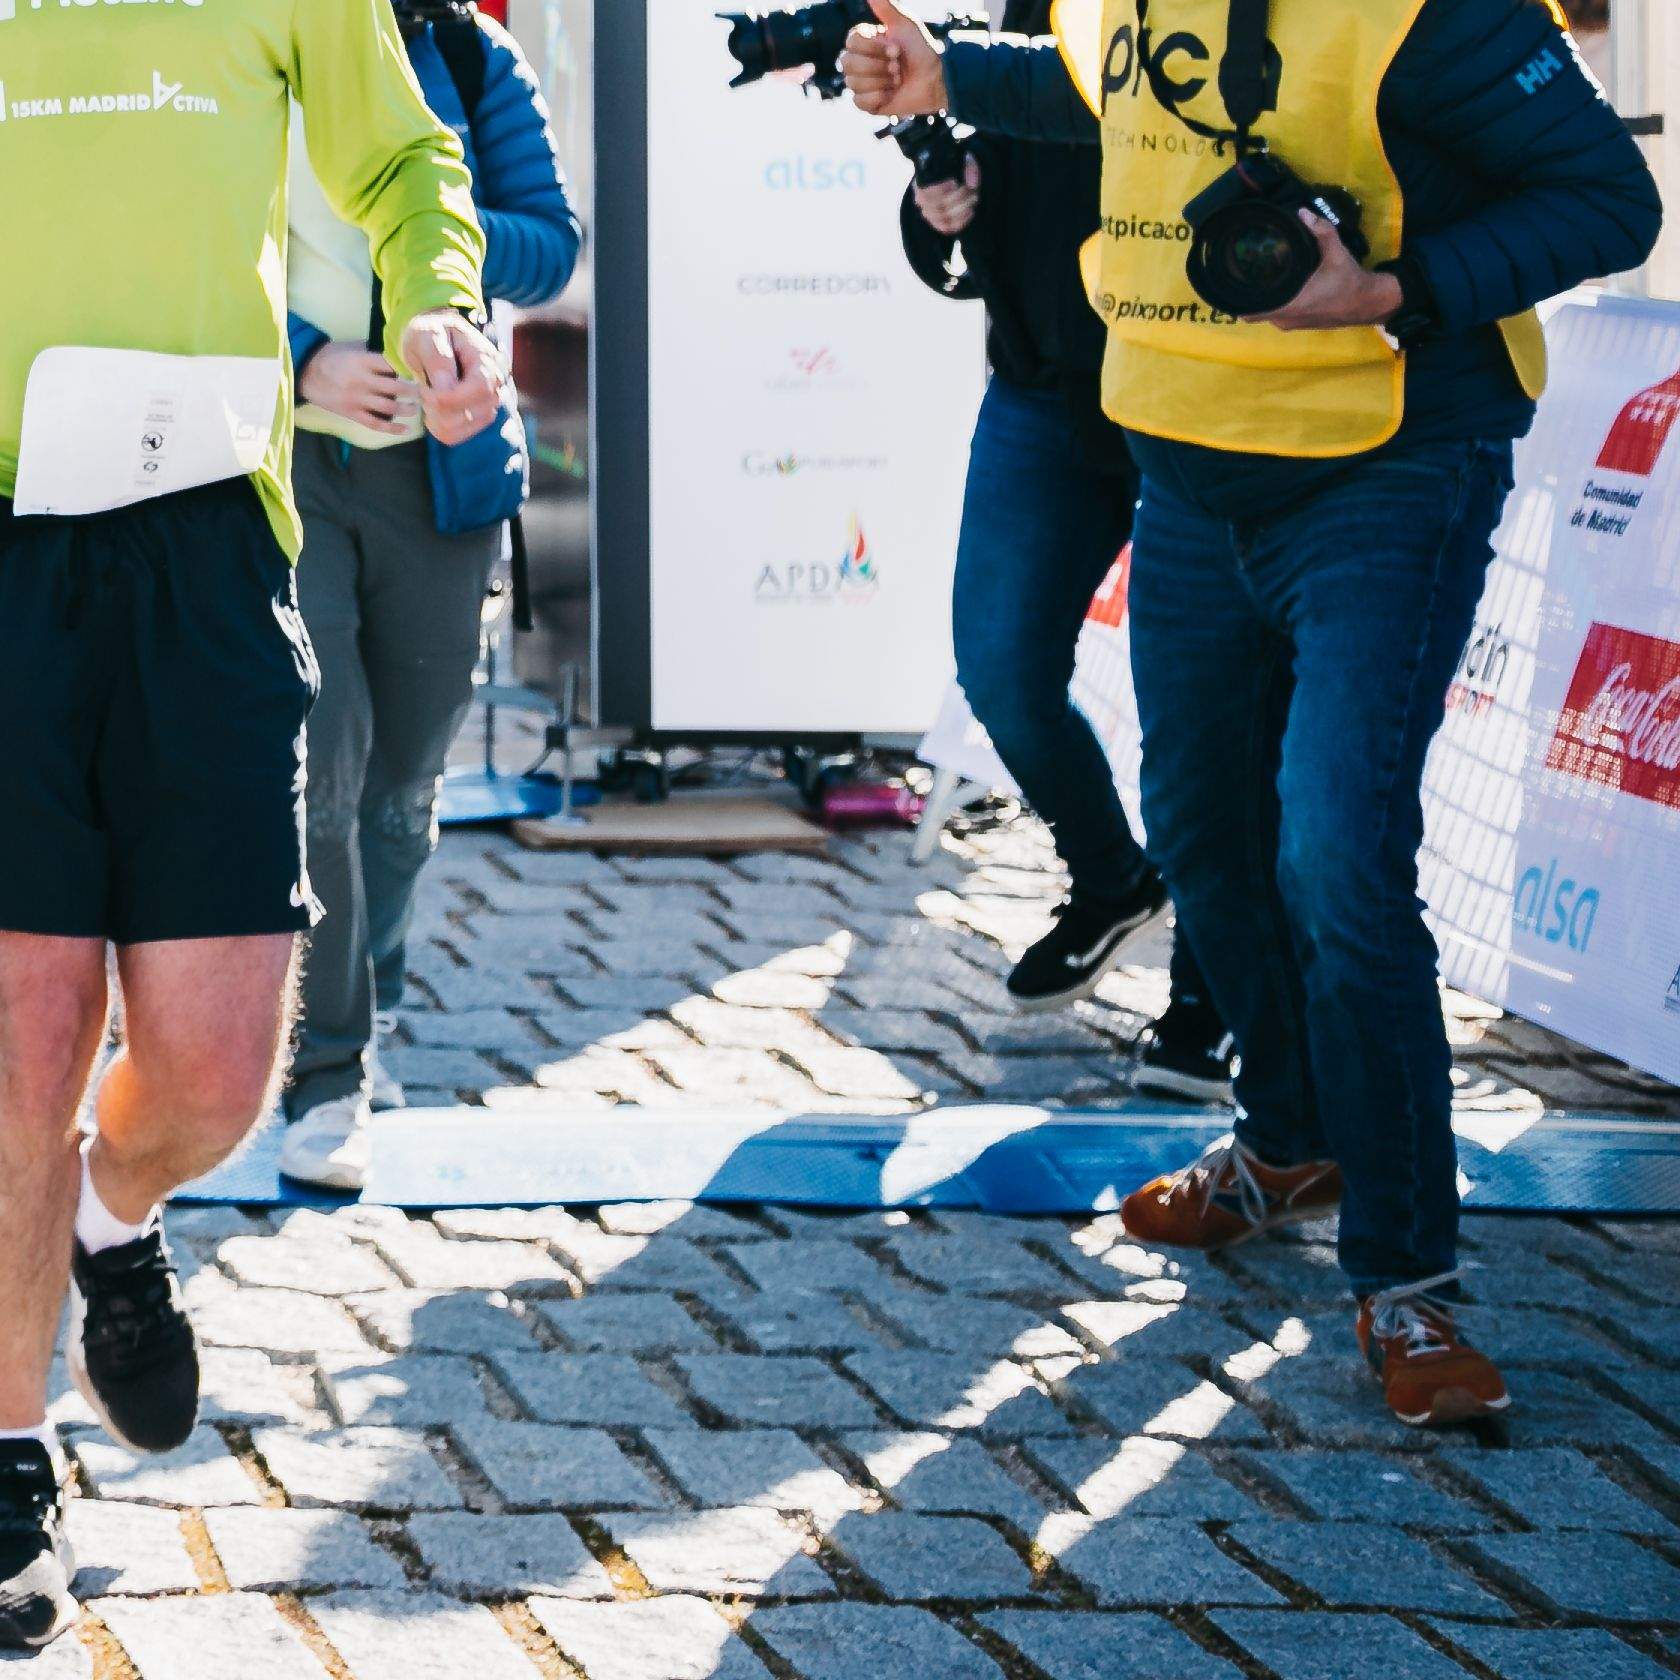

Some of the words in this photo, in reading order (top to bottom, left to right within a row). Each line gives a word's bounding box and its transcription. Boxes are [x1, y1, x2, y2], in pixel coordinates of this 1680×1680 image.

[1514, 47, 1564, 96] HH
[10, 97, 64, 119] 15KM
[69, 93, 151, 115] MADRID
[762, 154, 868, 192] alsa
[1582, 480, 1643, 508] Comunidad
[1569, 508, 1586, 528] de
[1586, 509, 1633, 536] Madrid
[1513, 858, 1601, 955] alsa
